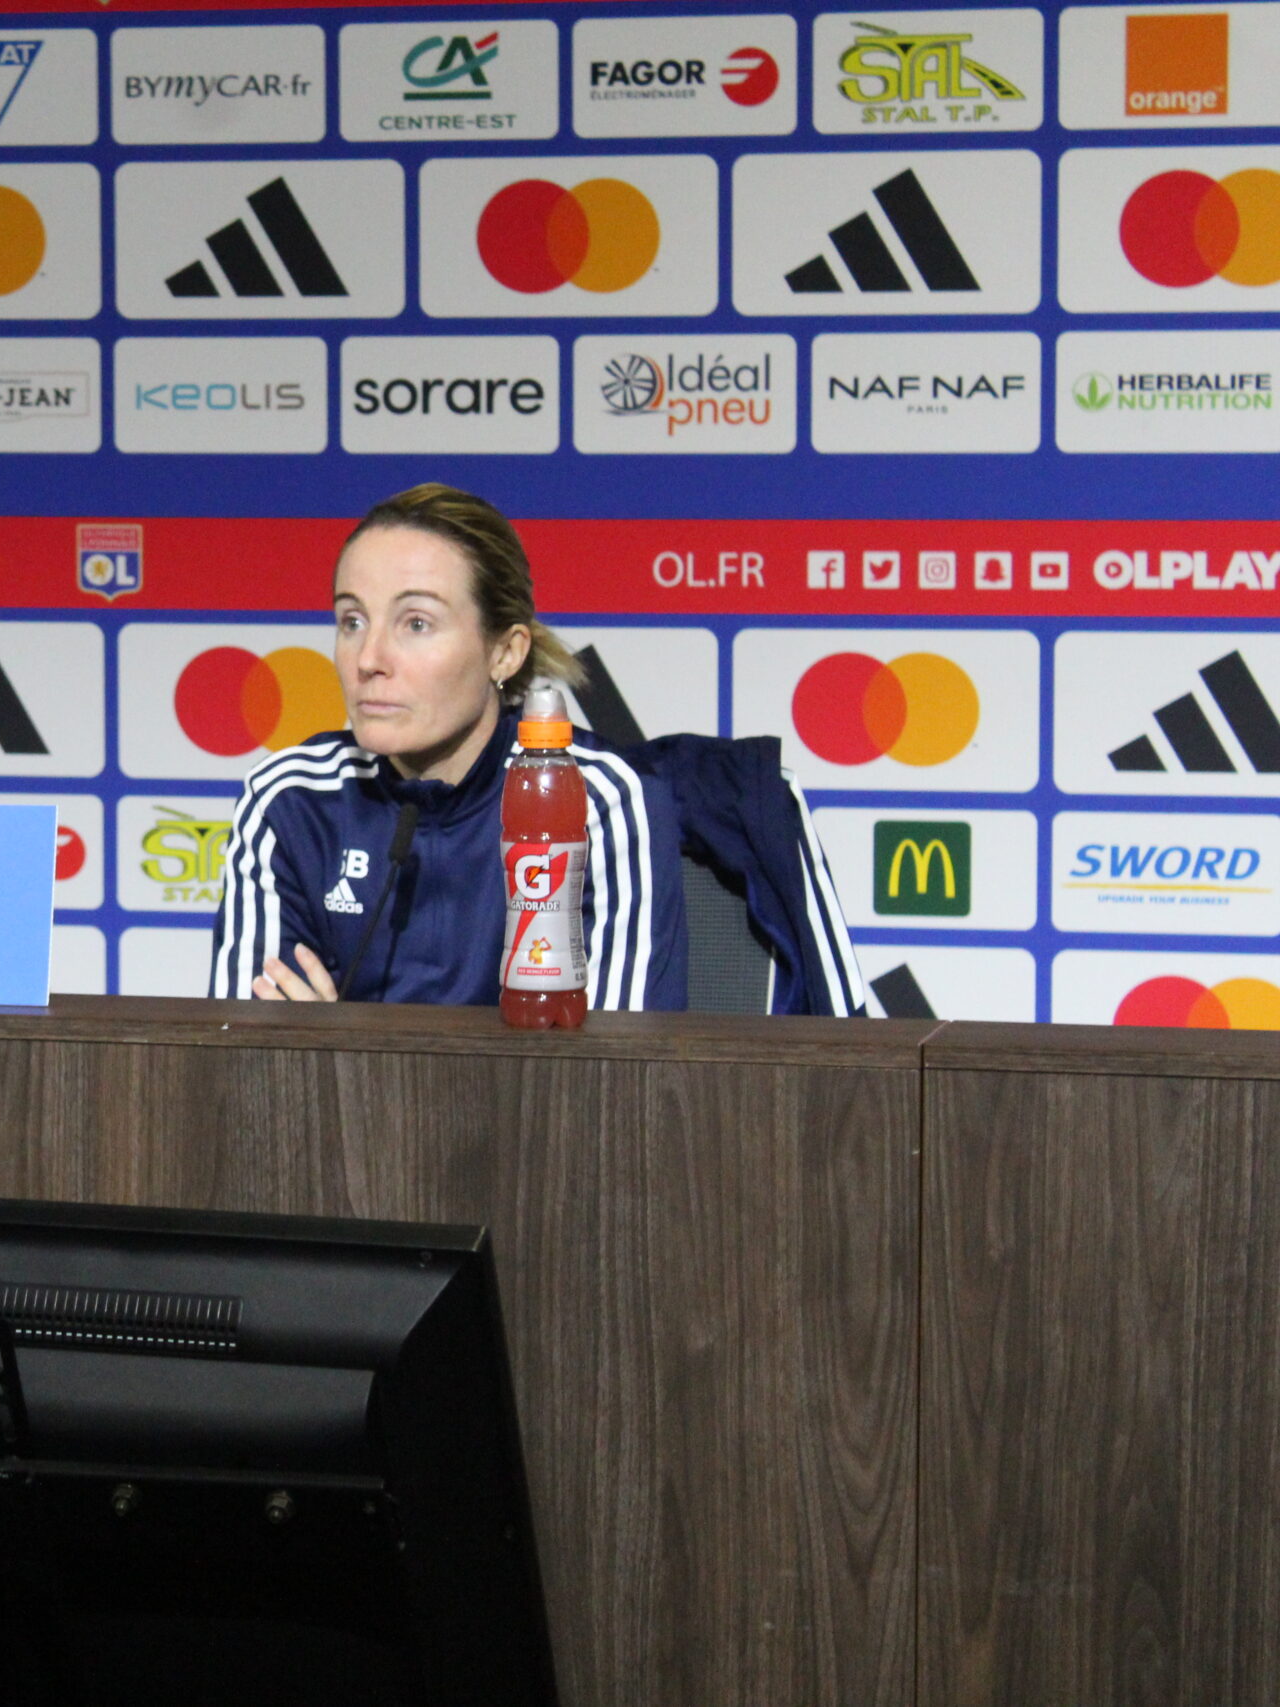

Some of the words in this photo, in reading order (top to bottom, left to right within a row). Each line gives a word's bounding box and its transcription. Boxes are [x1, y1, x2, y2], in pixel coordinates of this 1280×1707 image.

[590, 60, 705, 86] FAGOR
[861, 105, 936, 123] STAL
[950, 104, 999, 121] T.P.
[1129, 90, 1218, 113] orange
[378, 113, 517, 131] CENTRE-EST
[667, 353, 771, 392] Idéal
[1118, 374, 1272, 391] HERBALIFE
[353, 377, 544, 415] sorare
[829, 376, 921, 399] NAF
[933, 375, 1025, 399] NAF
[907, 405, 948, 414] PARIS
[1118, 393, 1272, 410] NUTRITION
[667, 397, 771, 436] pneu
[84, 554, 136, 587] OL
[652, 551, 765, 587] OL.FR
[1093, 550, 1280, 590] OLPLAY
[1069, 844, 1261, 880] SWORD
[510, 900, 560, 911] GATORADE
